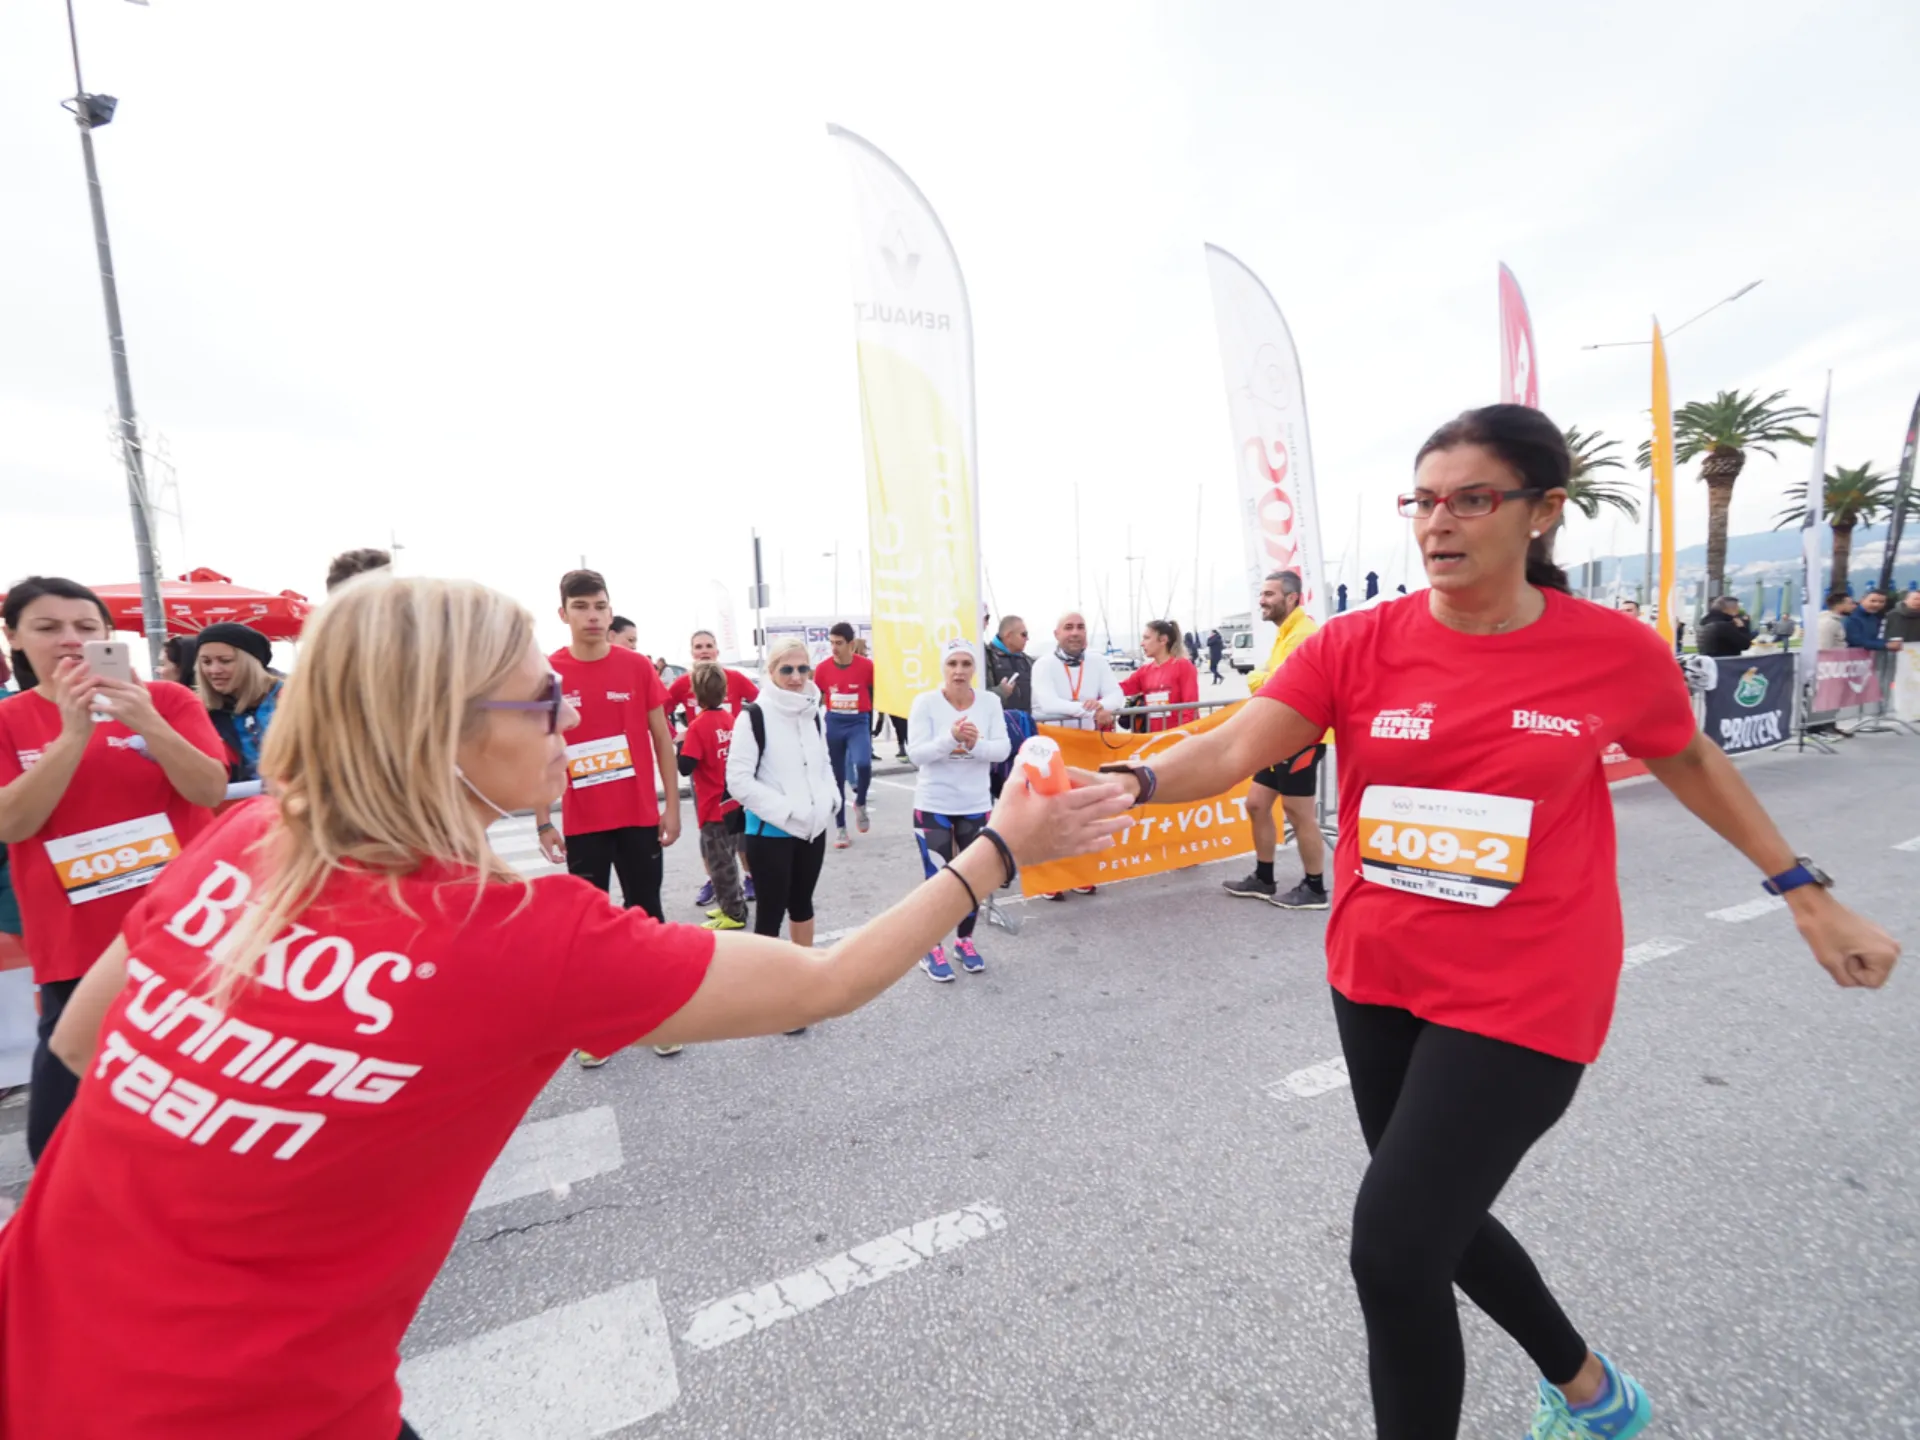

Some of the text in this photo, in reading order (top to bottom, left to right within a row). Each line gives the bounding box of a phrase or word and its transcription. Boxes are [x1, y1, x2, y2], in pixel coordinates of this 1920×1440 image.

[1370, 726, 1430, 740] RELAYS
[1372, 716, 1434, 729] STREET
[1104, 796, 1248, 848] TT+VOLT
[68, 838, 171, 879] 409-4
[1369, 824, 1511, 873] 409-2
[1391, 877, 1478, 900] STREET RELAYS
